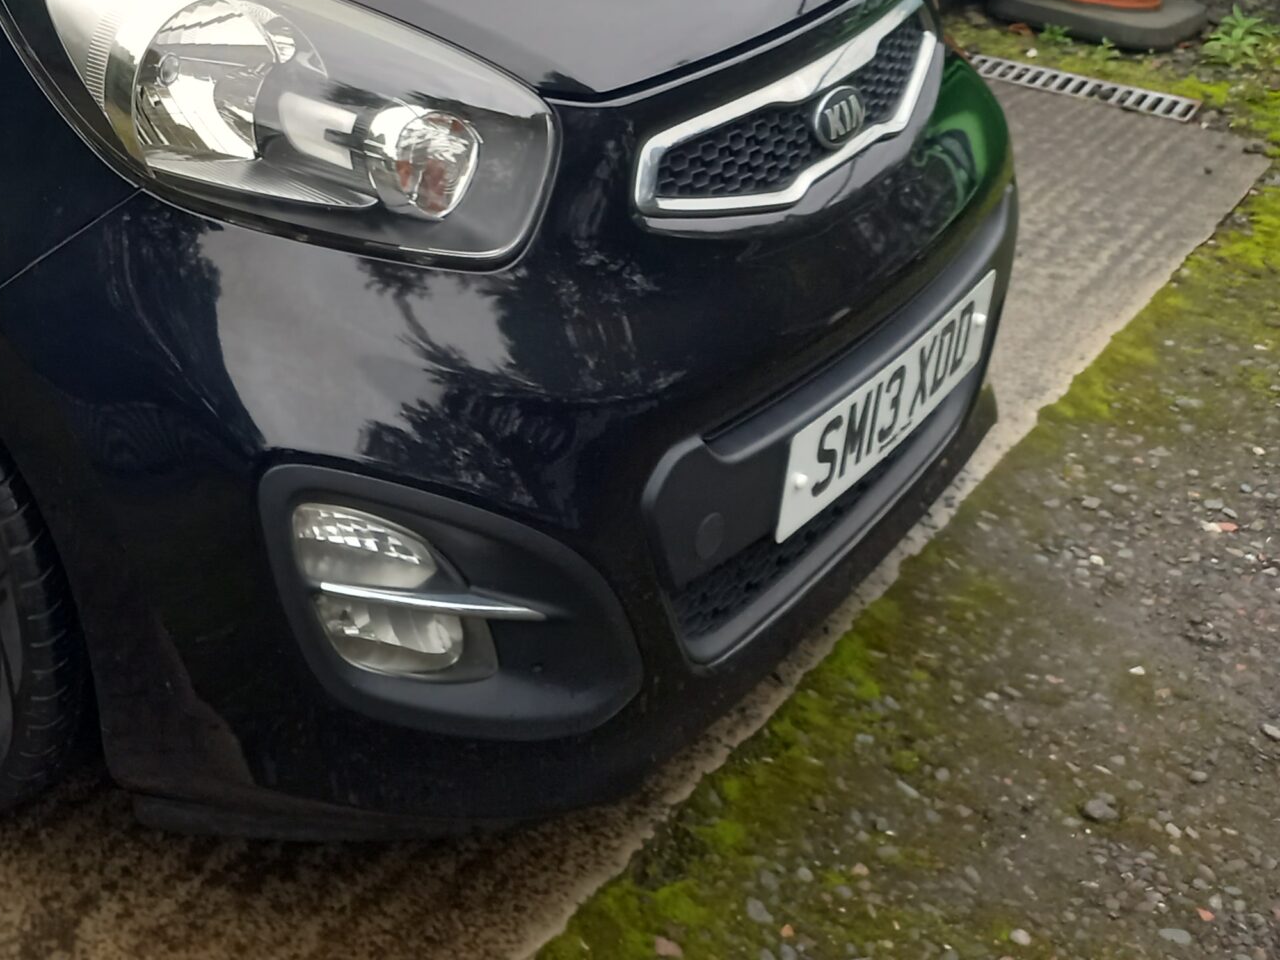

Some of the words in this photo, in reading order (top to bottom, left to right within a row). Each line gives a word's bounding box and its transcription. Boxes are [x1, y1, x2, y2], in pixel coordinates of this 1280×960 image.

[823, 94, 864, 141] KIA
[811, 364, 907, 498] SM13
[908, 300, 976, 418] XDD
